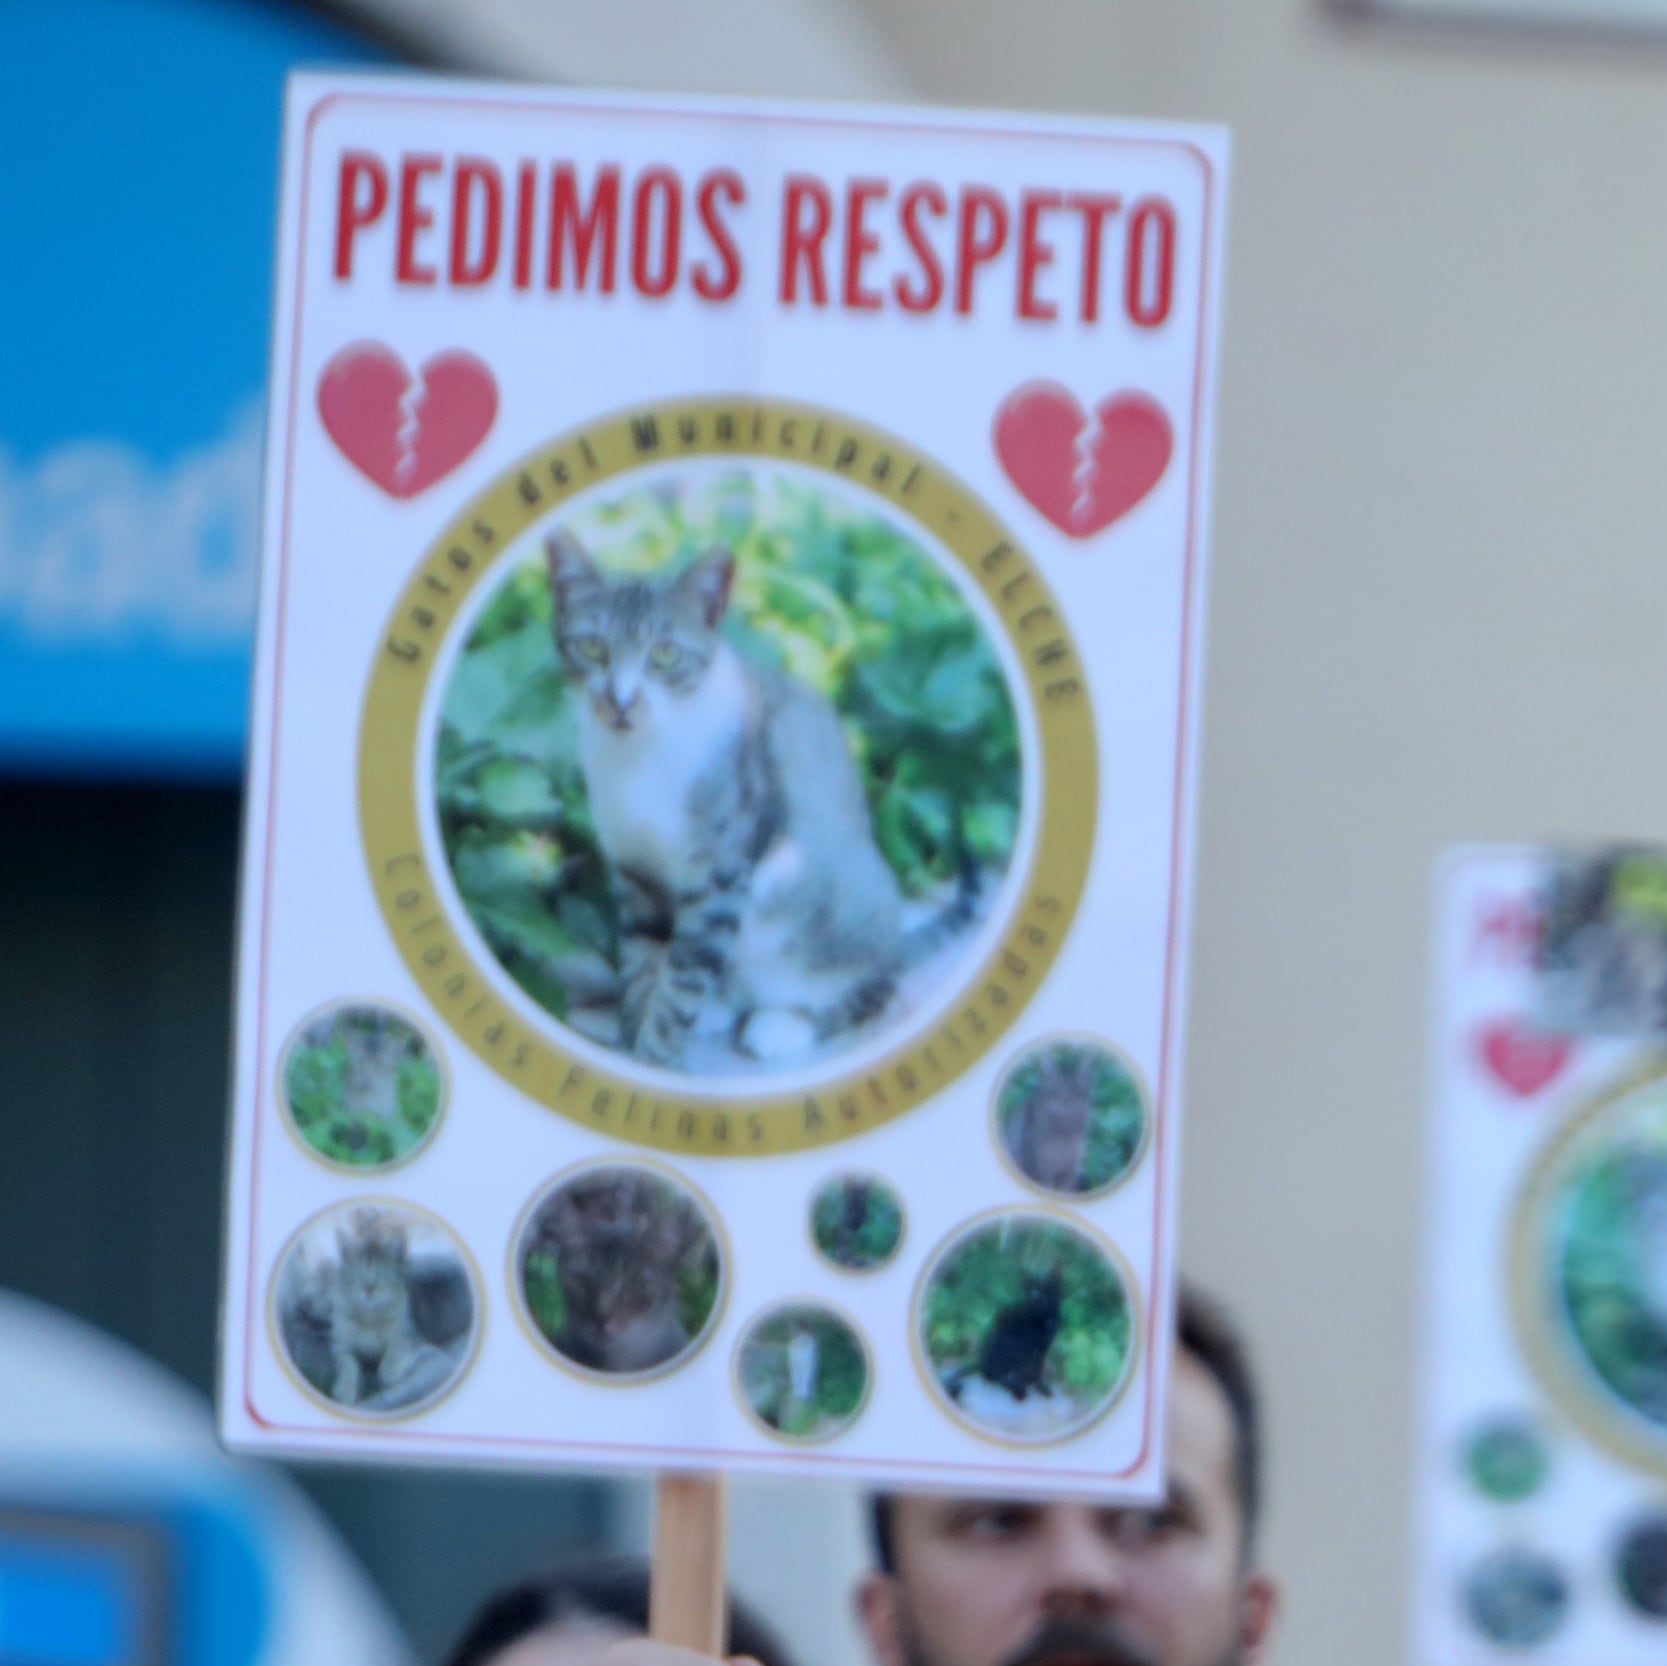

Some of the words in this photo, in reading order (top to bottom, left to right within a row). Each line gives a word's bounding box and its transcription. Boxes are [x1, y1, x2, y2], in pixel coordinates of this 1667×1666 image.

[332, 148, 747, 303] PEDIMOS
[779, 171, 1177, 330] RESPETO
[385, 516, 498, 664] Gatos
[516, 434, 599, 508] del
[629, 404, 924, 496] Municipal
[979, 539, 1081, 699] ELCHE
[384, 853, 533, 1069] Colonias
[802, 895, 1061, 1133] Autorizadas
